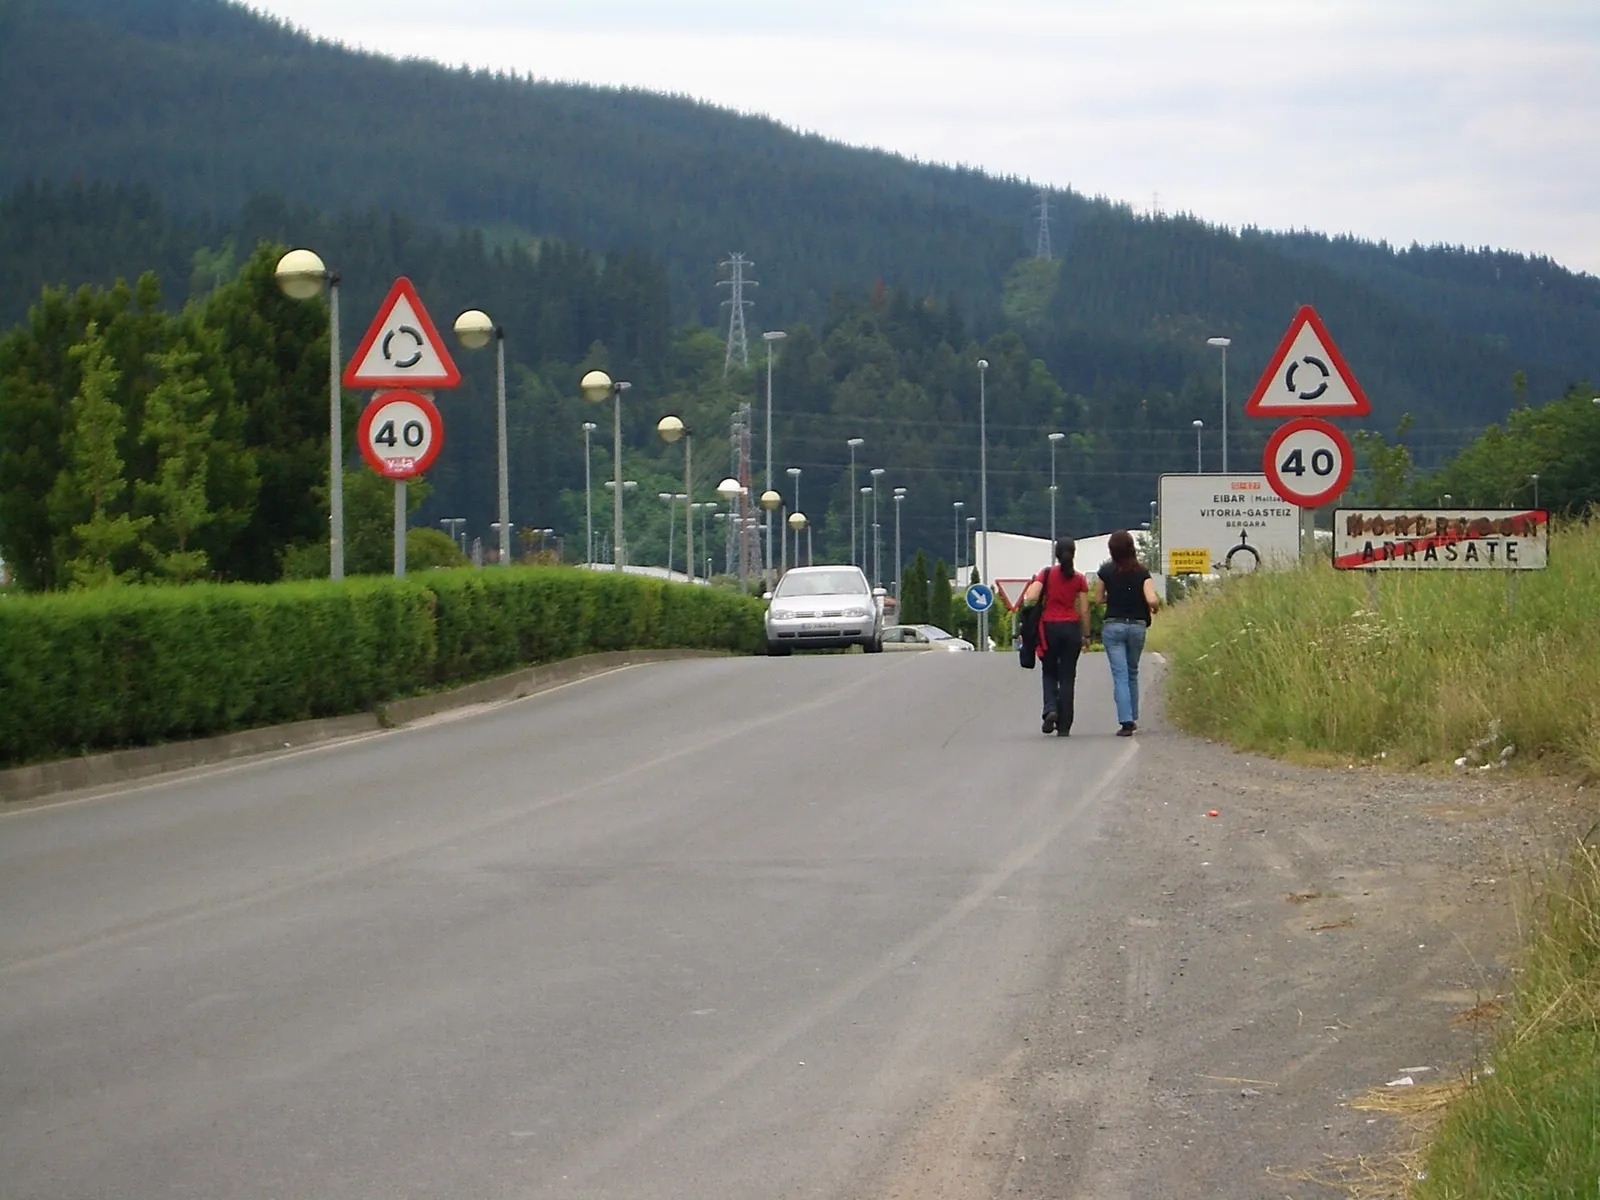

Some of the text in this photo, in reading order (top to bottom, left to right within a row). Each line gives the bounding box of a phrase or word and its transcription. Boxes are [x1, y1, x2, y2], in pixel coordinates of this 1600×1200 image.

[375, 420, 424, 447] 40
[1281, 448, 1334, 476] 40
[1213, 494, 1245, 503] EIBAR
[1200, 508, 1292, 517] VITORIA-GASTEIZ
[1363, 541, 1519, 562] ARRASATE
